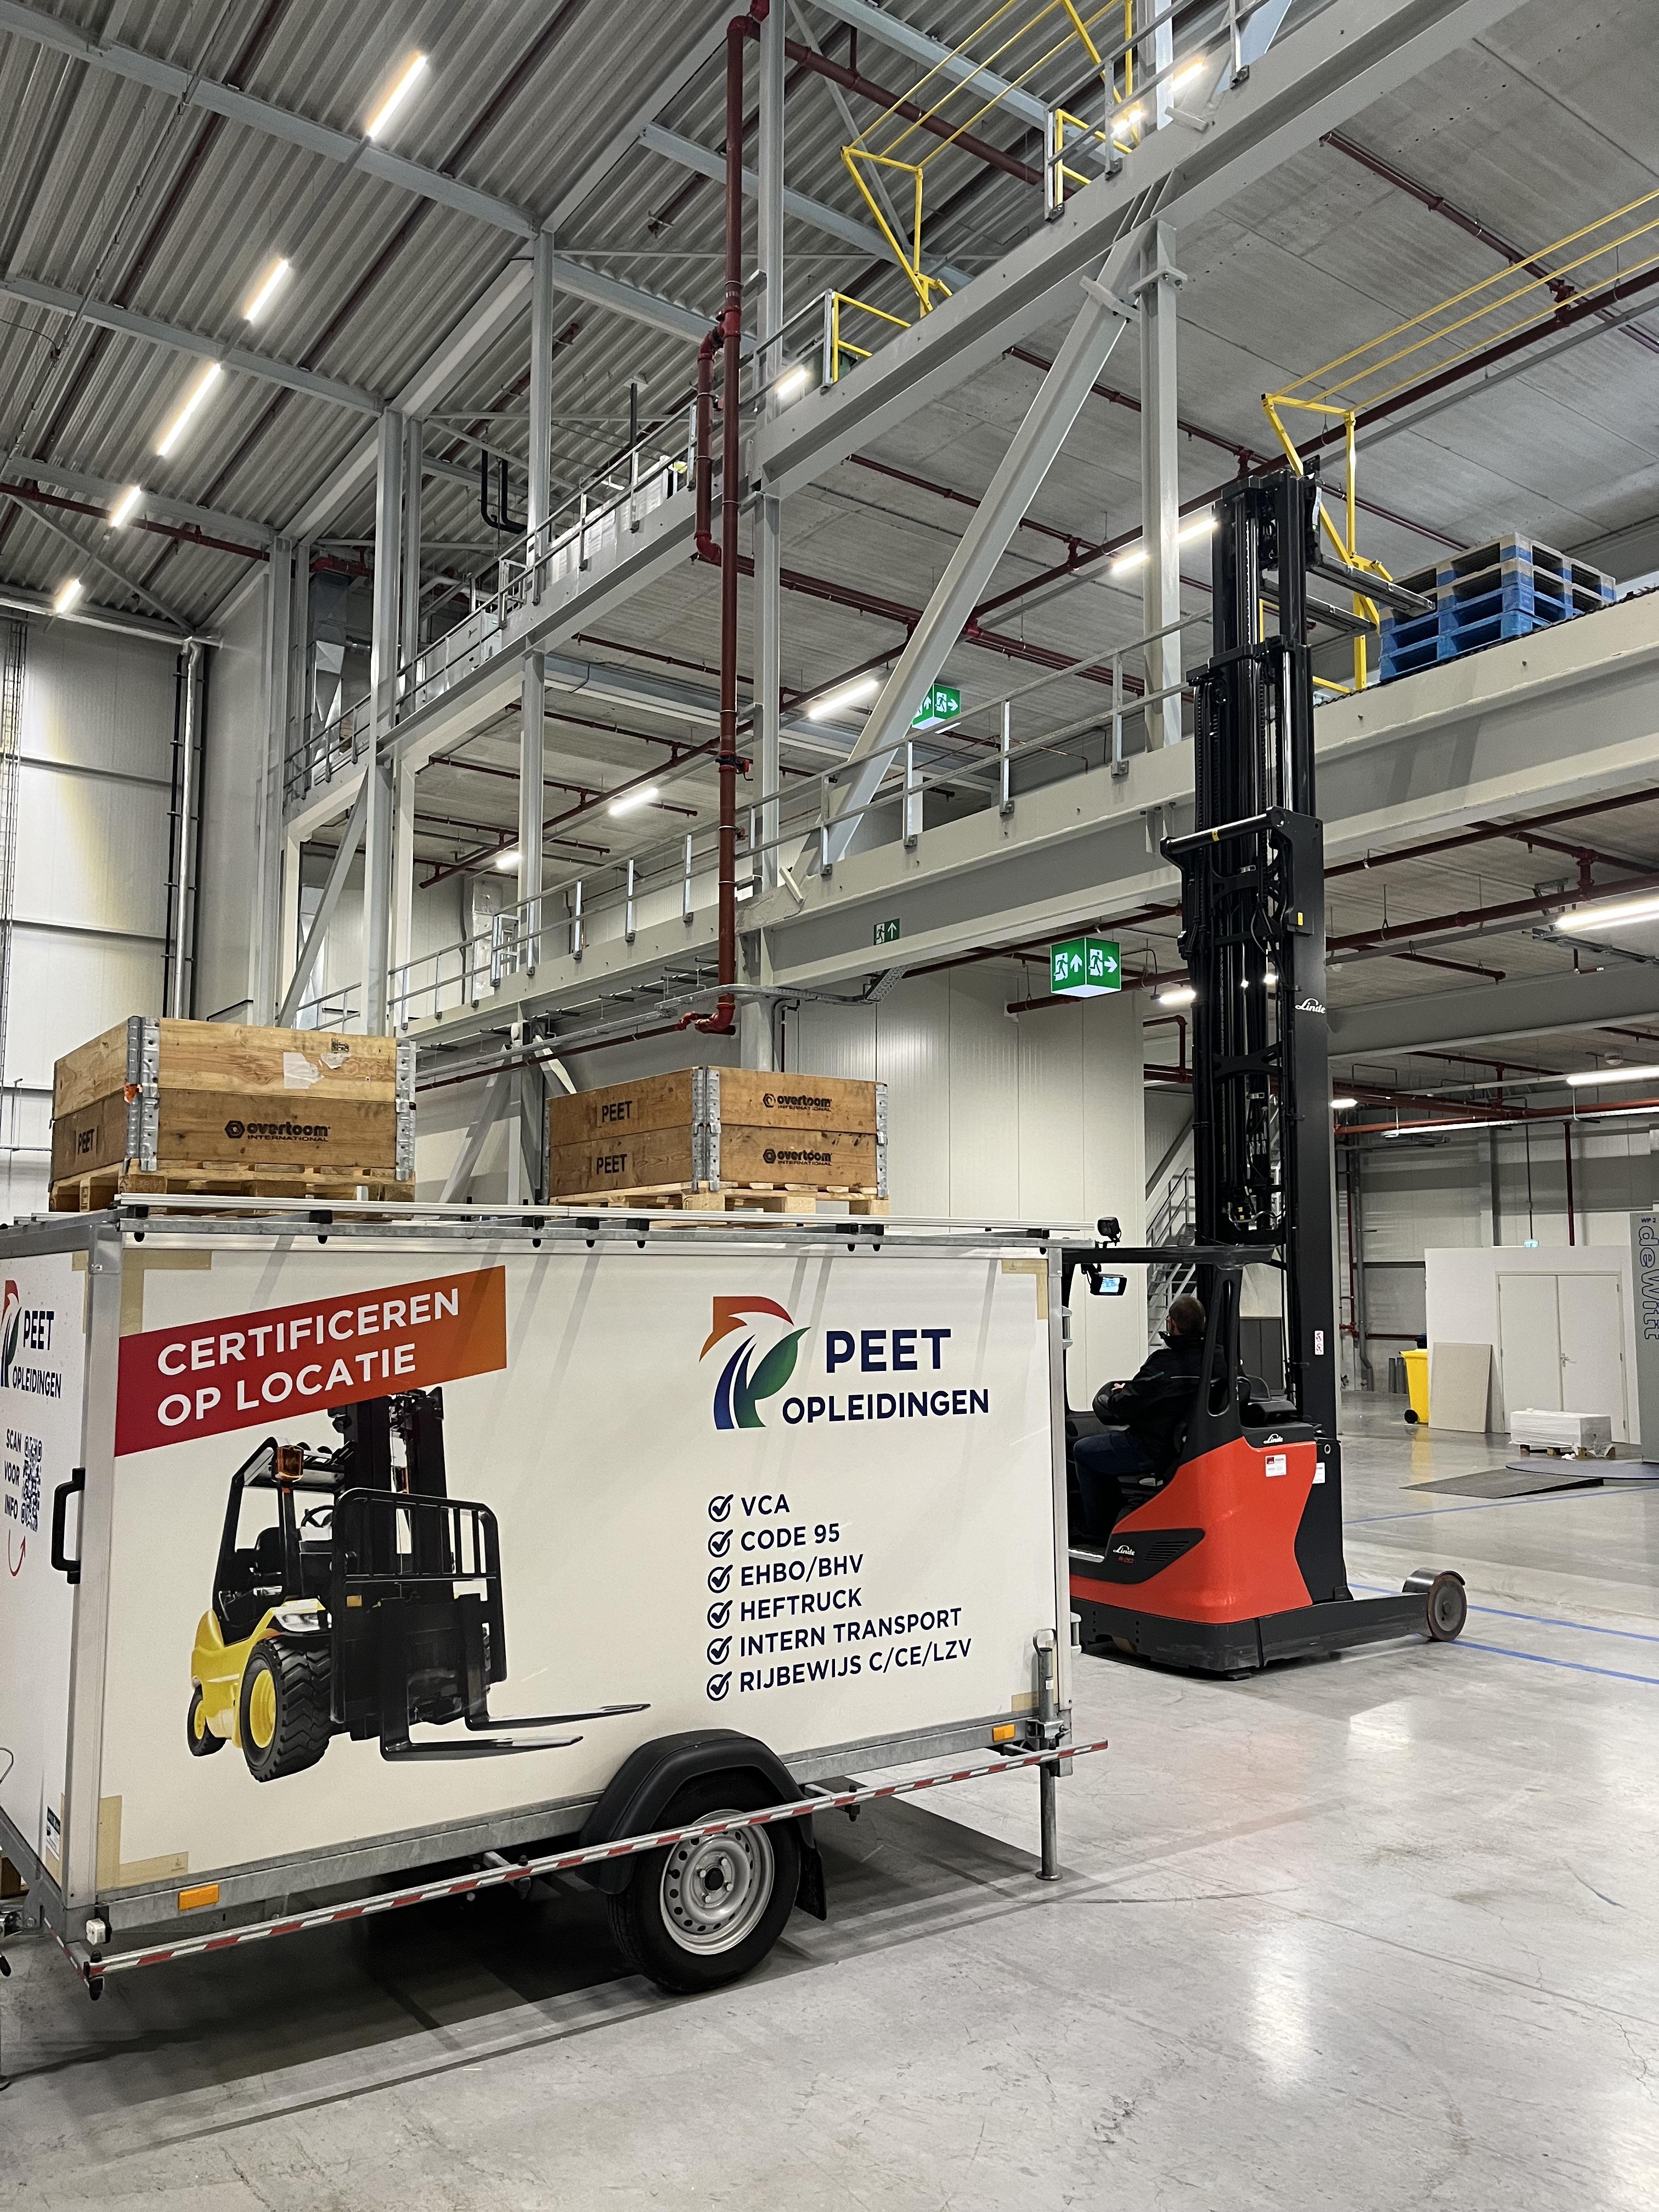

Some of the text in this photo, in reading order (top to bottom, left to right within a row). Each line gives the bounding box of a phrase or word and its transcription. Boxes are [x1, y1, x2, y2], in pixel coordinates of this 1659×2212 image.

[1295, 998, 1326, 1014] Linde
[601, 1100, 633, 1123] PEET
[777, 1094, 831, 1107] overtoom
[77, 1128, 95, 1155] PEET
[247, 1121, 328, 1137] overtoom
[596, 1153, 628, 1175] PEET
[777, 1149, 832, 1162] overtoom
[23, 1310, 54, 1351] PEET
[157, 1288, 459, 1376] CERTIFICEREN
[826, 1328, 951, 1373] PEET
[12, 1365, 61, 1399] OPLEIDINGEN
[157, 1343, 416, 1426] OP LOCATIE
[782, 1389, 989, 1425] OPLEIDINGEN
[6, 1428, 22, 1453] SCAN
[4, 1459, 20, 1487] VOOR
[4, 1493, 19, 1520] INFO
[741, 1493, 790, 1516] VCA
[741, 1522, 840, 1551] CODE 95
[1113, 1544, 1135, 1556] Linde
[741, 1554, 864, 1587] EHBO/BHV
[740, 1587, 862, 1622] HEFTRUCK
[740, 1607, 962, 1657] INTERN TRANSPORT
[740, 1638, 972, 1692] RIJBEWIJS C/CE/LZV
